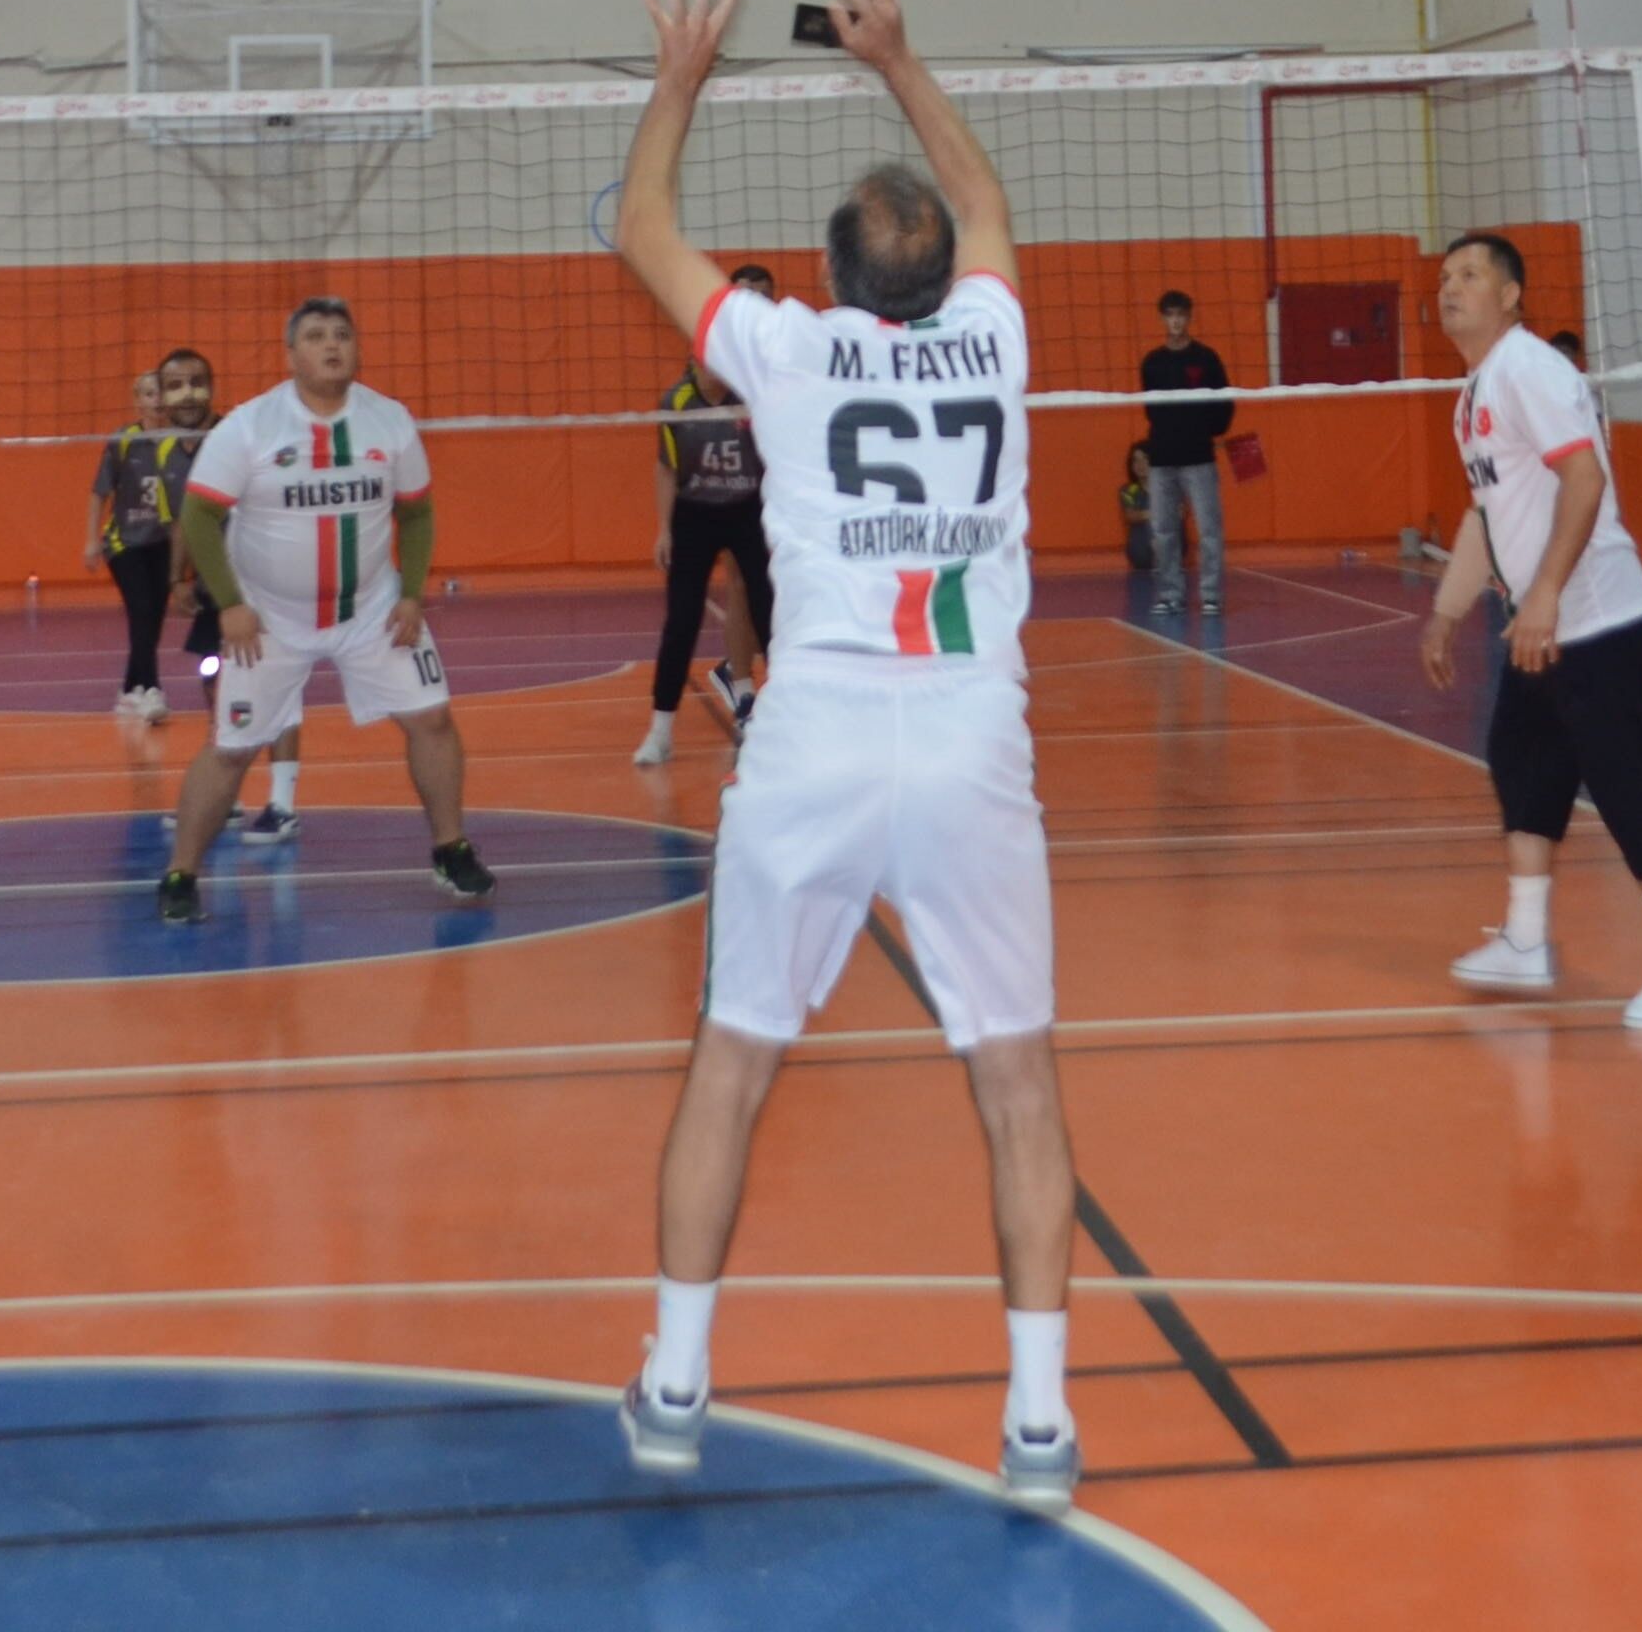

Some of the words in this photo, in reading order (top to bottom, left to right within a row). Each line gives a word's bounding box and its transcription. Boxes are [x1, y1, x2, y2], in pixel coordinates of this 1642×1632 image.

[828, 336, 878, 381] M.
[890, 330, 1004, 381] FATİH
[702, 439, 743, 472] 45
[827, 395, 1005, 505] 67
[284, 476, 384, 509] FİLİSTİN
[839, 509, 929, 559] ATATÜRK
[411, 648, 443, 687] 10
